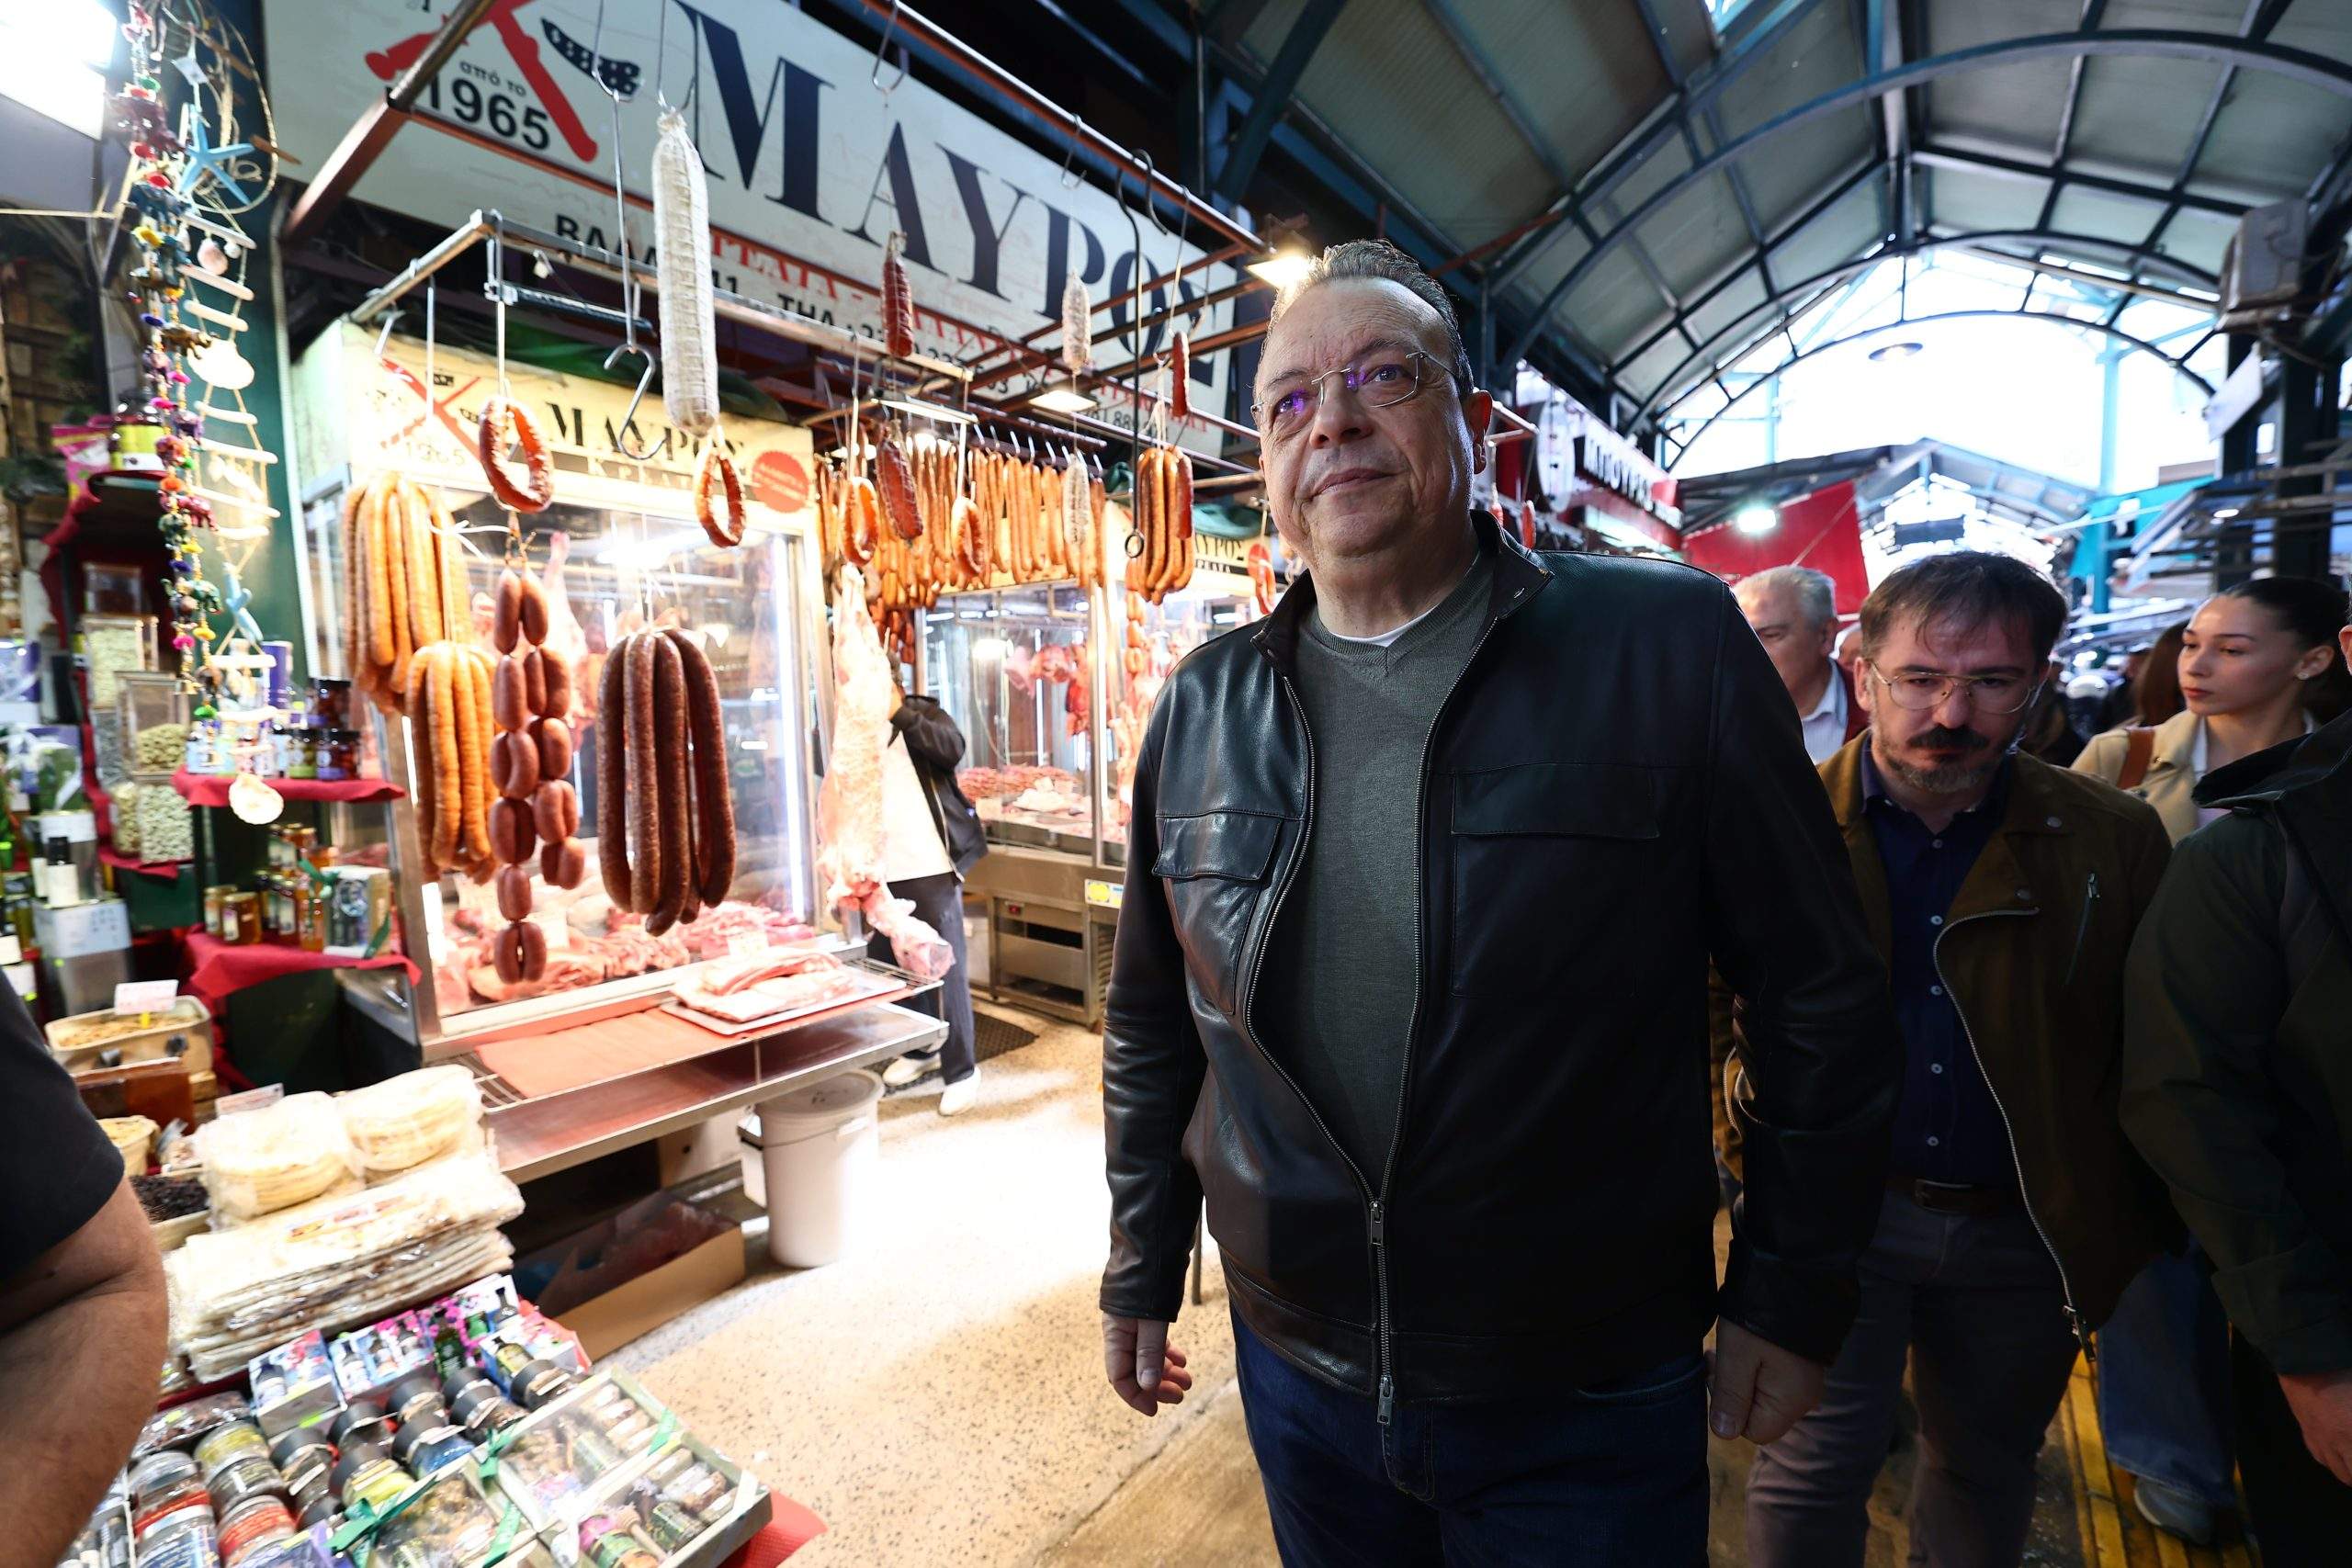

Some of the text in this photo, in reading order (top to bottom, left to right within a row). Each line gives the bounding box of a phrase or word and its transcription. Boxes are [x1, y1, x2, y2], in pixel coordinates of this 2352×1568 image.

[461, 60, 527, 97] από το
[429, 73, 551, 151] 1965
